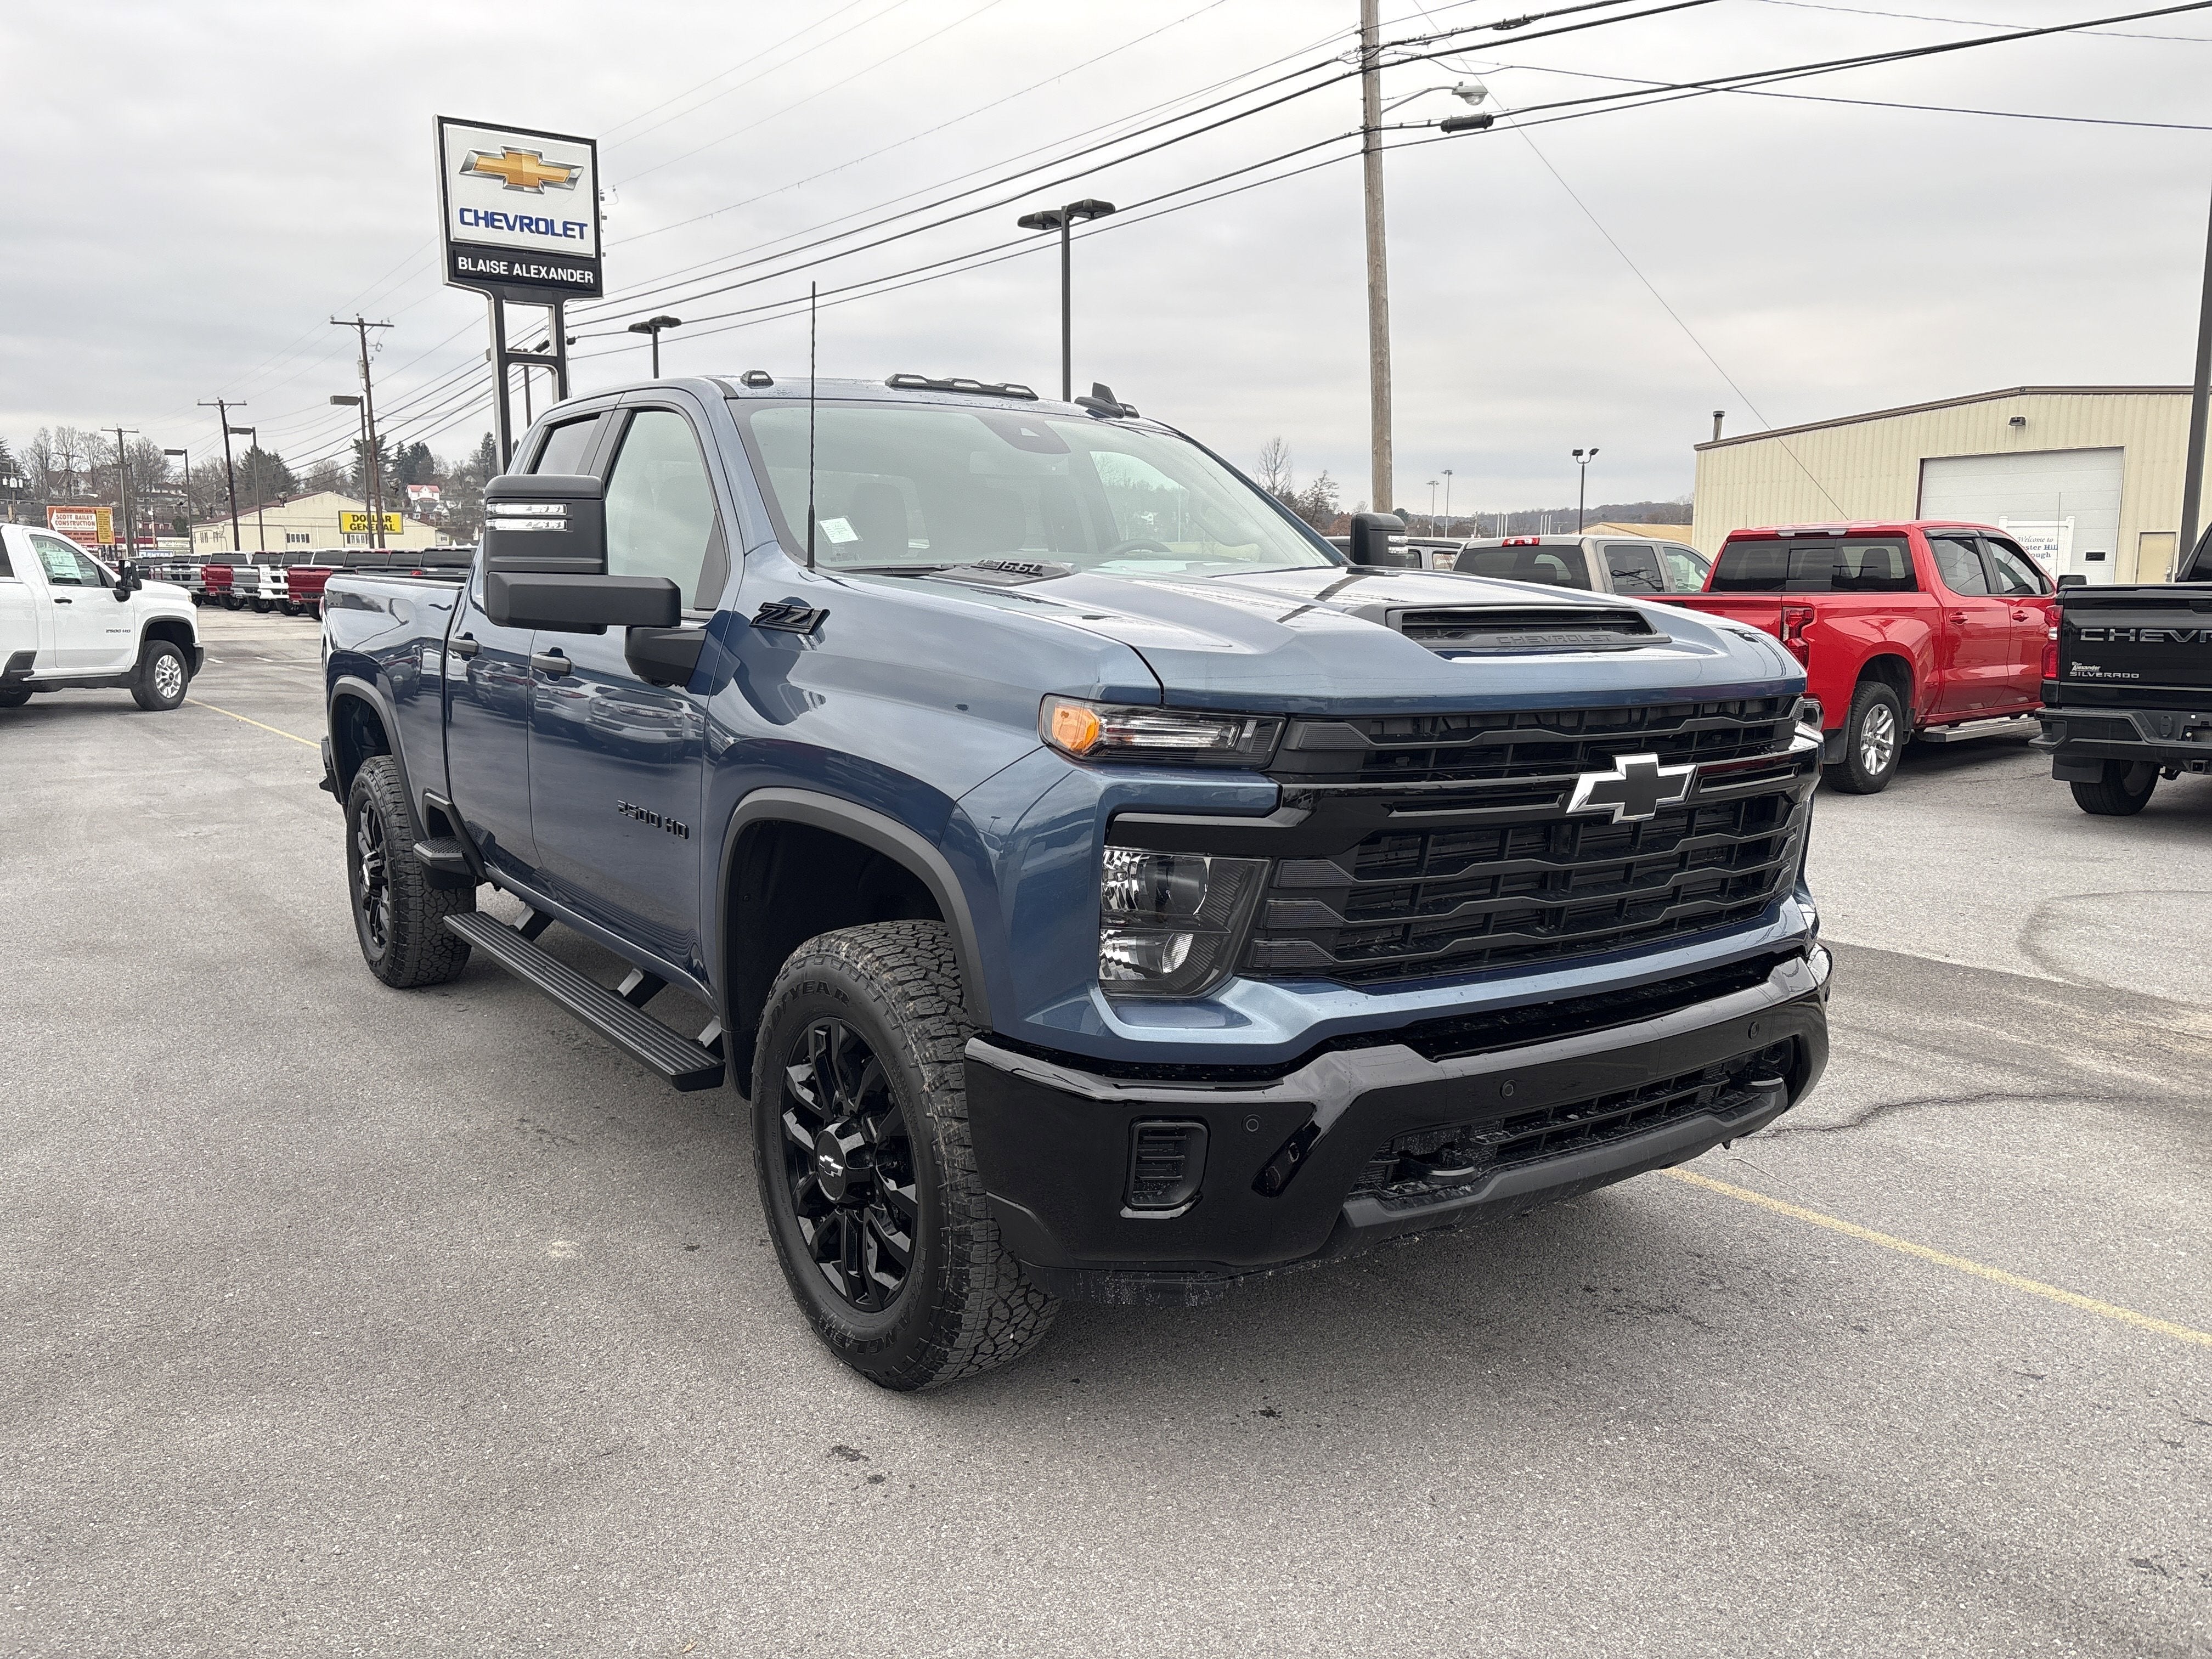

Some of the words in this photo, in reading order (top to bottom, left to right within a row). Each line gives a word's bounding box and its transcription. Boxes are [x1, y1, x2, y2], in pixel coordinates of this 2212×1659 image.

[459, 207, 588, 240] CHEVROLET
[458, 256, 509, 275] BLAISE
[512, 263, 594, 284] ALEXANDER
[349, 523, 396, 531] GENEAL
[351, 514, 392, 523] DOLR
[1496, 635, 1611, 644] CHEVROLET
[617, 799, 662, 828] 2500
[664, 816, 690, 839] HD
